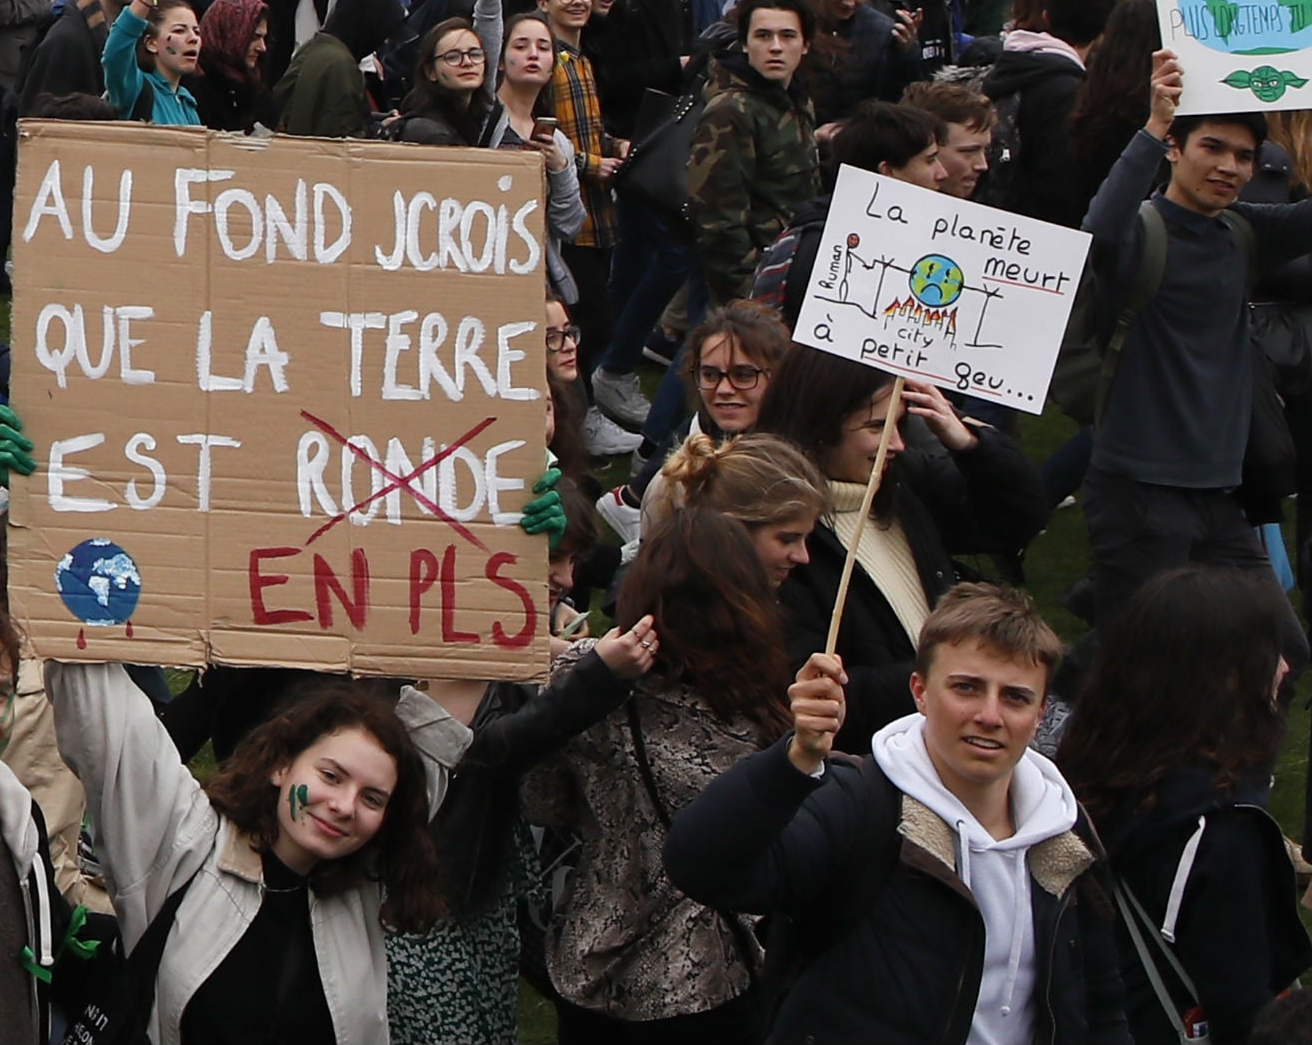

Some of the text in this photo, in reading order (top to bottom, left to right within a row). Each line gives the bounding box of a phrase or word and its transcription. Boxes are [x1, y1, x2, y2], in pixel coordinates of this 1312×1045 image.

[1169, 4, 1306, 41] PLUS LONGTEMPS TU
[22, 159, 540, 276] AU FOND JCROIS
[866, 182, 908, 225] La
[983, 257, 1071, 293] meurt
[813, 313, 833, 343] à
[897, 327, 934, 349] city
[35, 303, 540, 401] QUE LA TERRE
[860, 338, 928, 368] petit
[47, 431, 527, 527] EST RONDE
[248, 542, 537, 648] EN PLS
